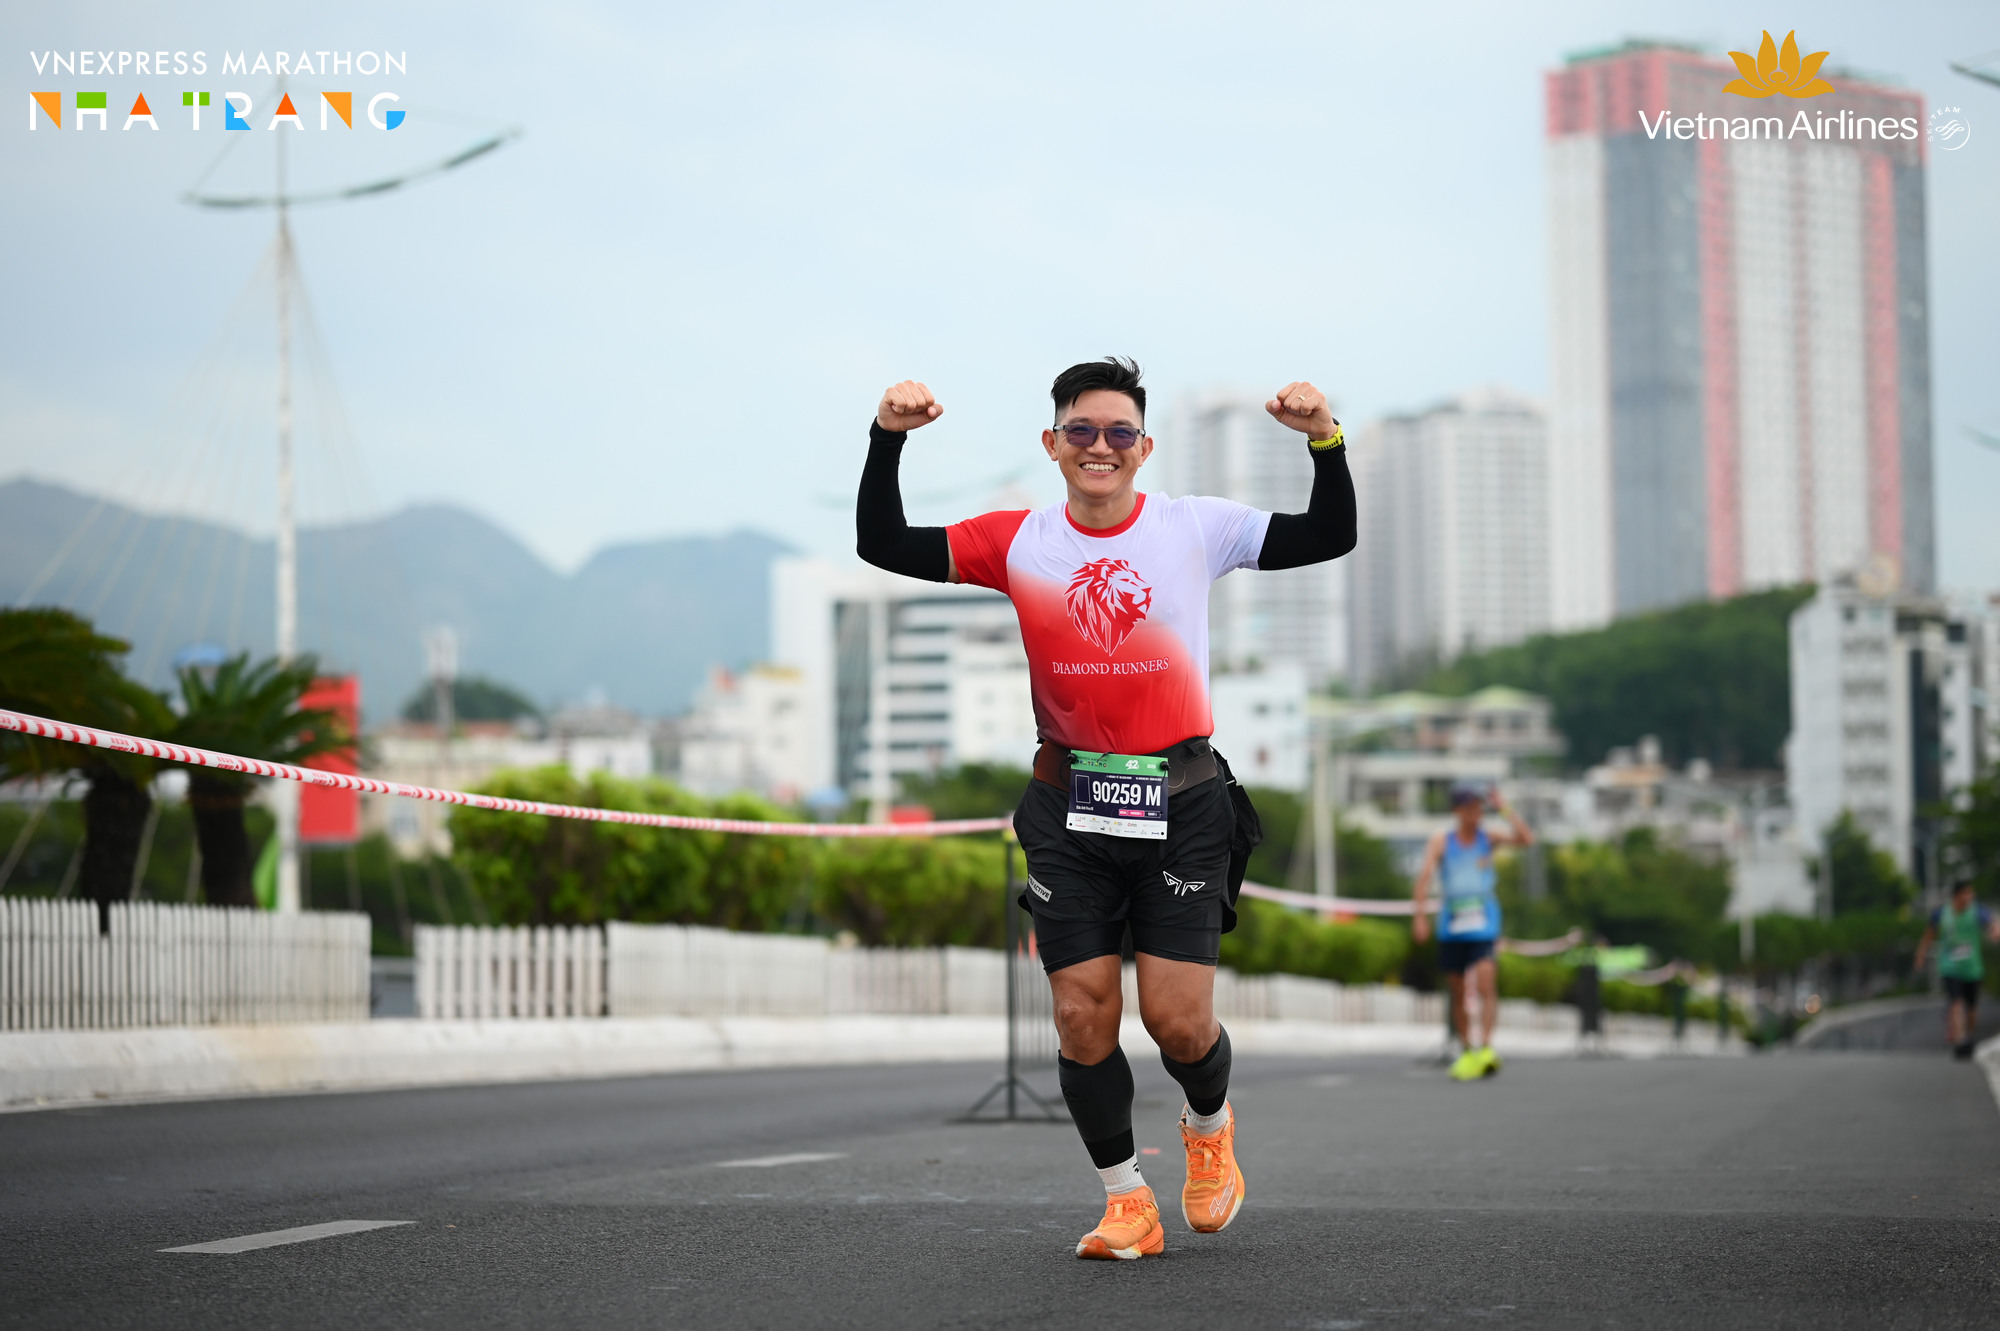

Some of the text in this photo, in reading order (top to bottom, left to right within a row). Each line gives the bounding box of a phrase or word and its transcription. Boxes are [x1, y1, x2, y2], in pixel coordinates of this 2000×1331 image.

[1052, 657, 1169, 675] DIAMOND RUNNERS
[1125, 759, 1138, 770] 42
[1092, 780, 1161, 807] 90259 M
